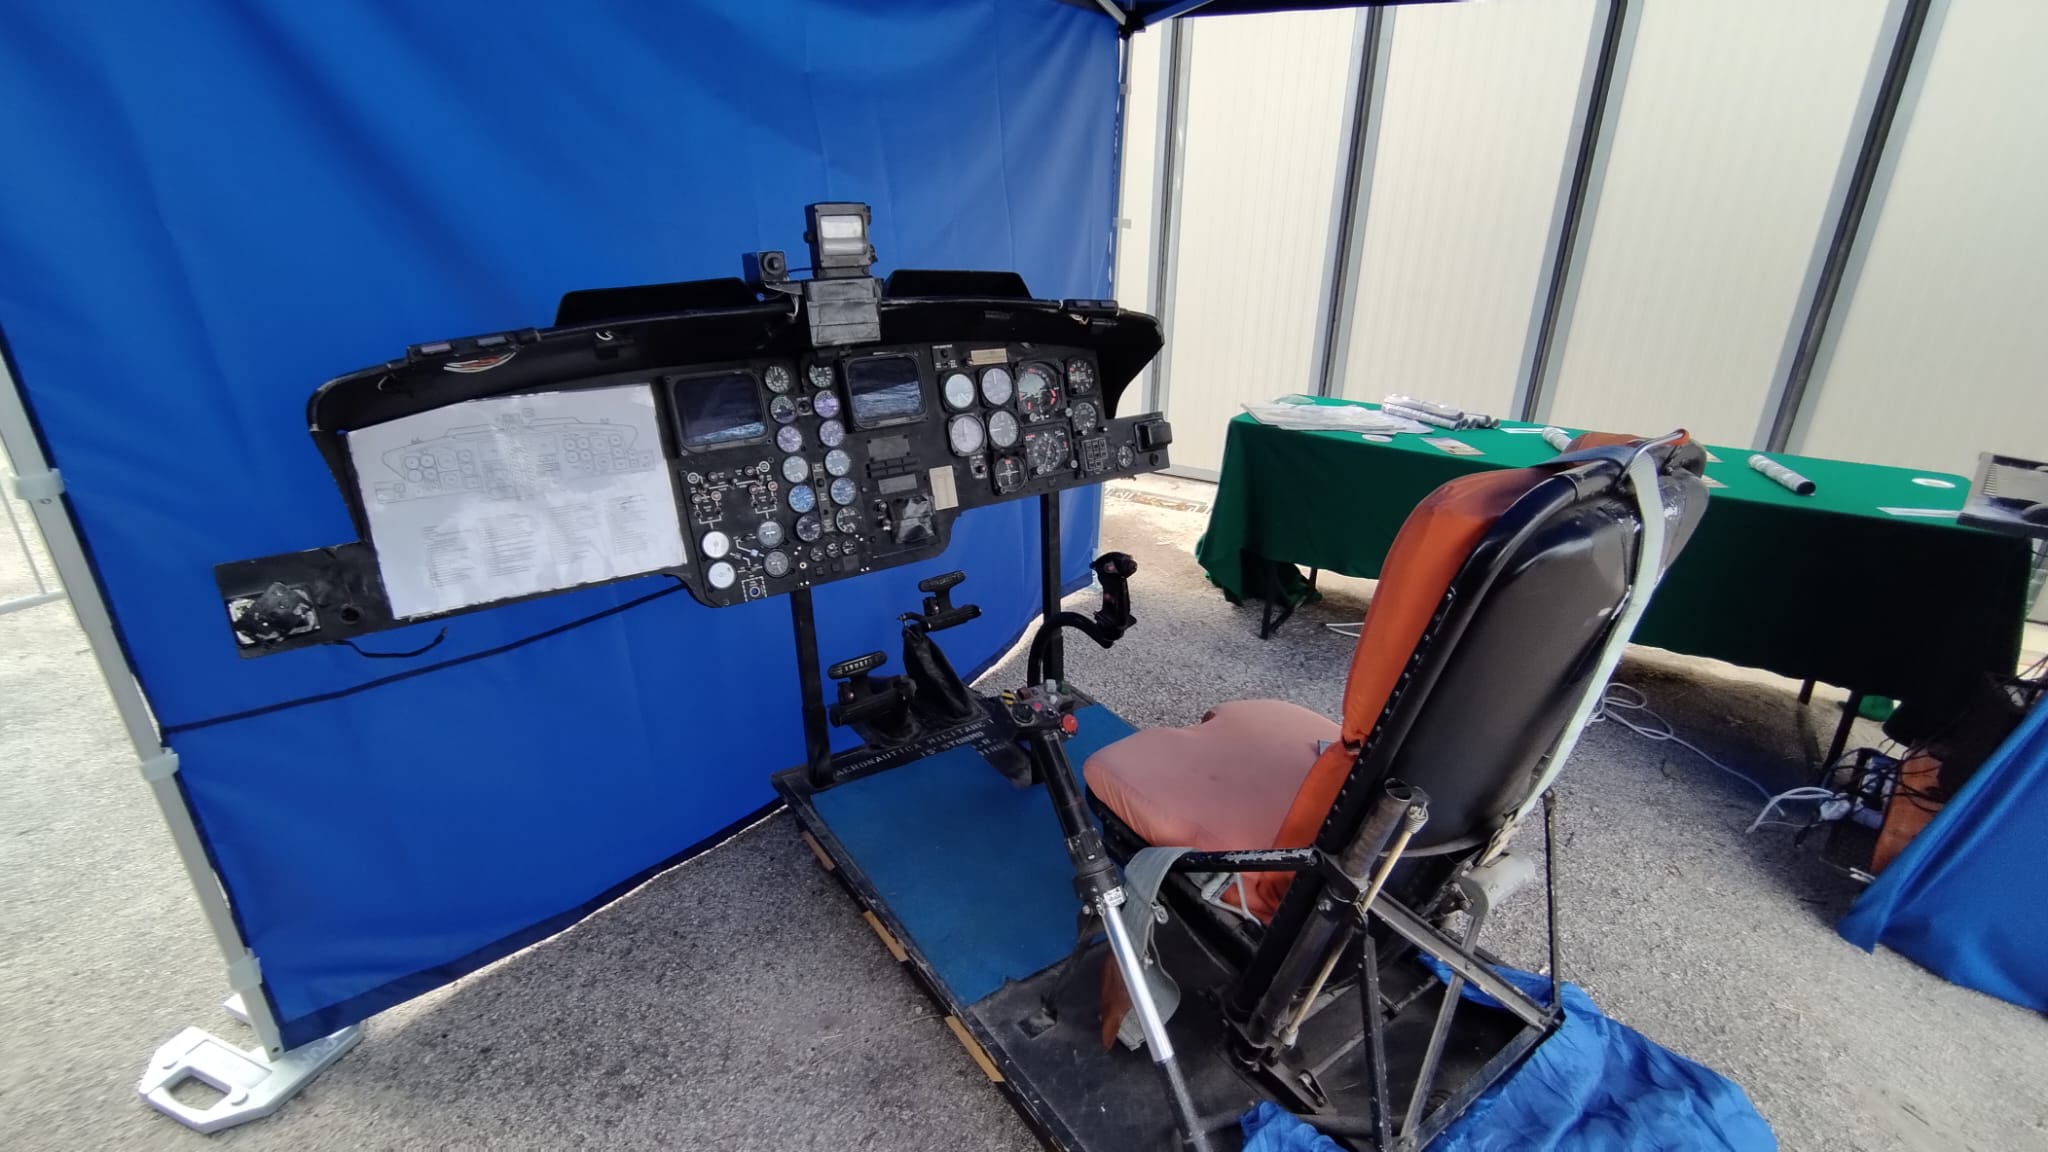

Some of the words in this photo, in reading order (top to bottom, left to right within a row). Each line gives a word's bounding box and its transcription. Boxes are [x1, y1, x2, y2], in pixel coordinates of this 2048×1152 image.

[835, 743, 921, 777] AERONAUTICA
[927, 721, 986, 745] MILITARE
[941, 731, 985, 749] STORMO
